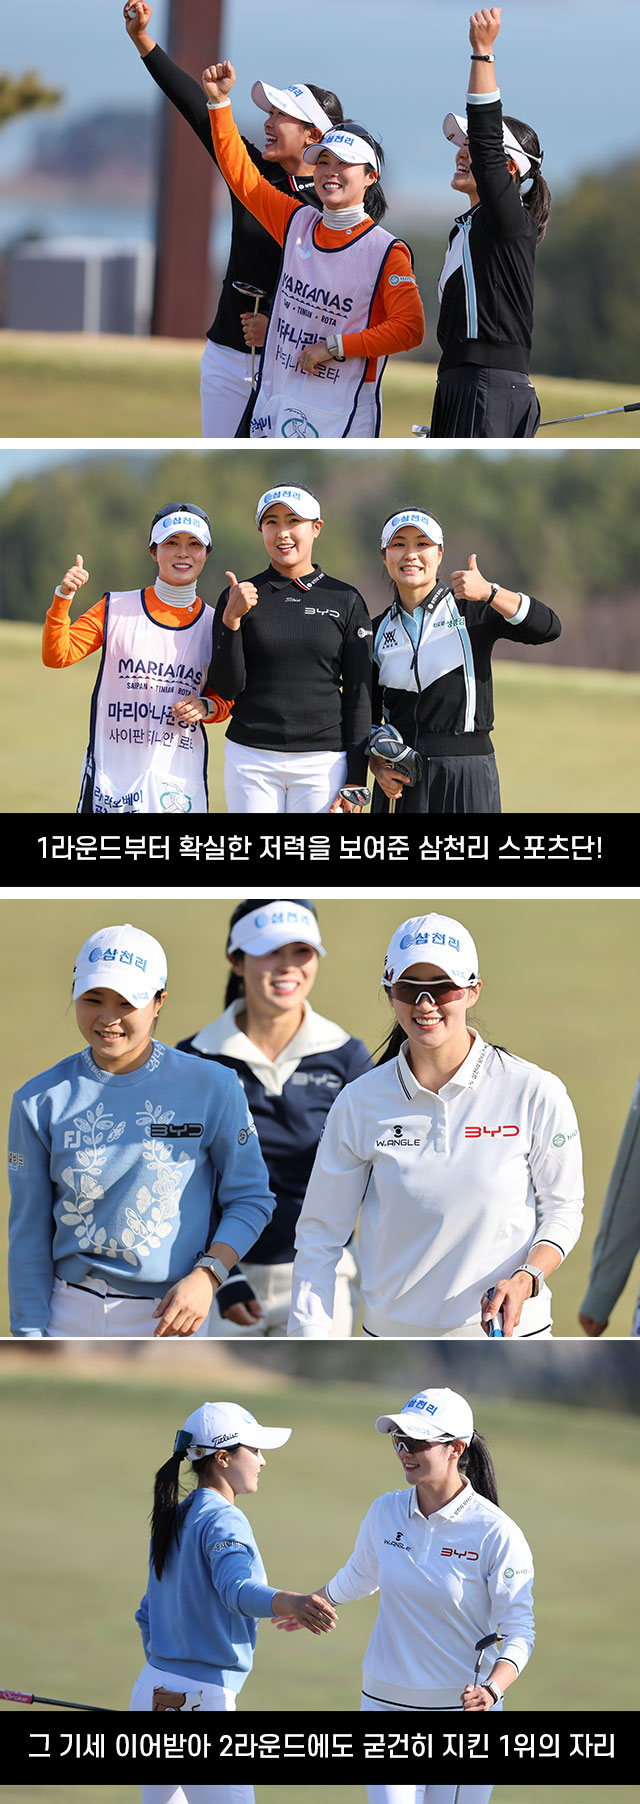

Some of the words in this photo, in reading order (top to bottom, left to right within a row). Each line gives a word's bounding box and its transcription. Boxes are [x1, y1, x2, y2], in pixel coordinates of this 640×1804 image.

[272, 490, 301, 501] 삼천리
[401, 514, 429, 526] 삼천리
[304, 607, 340, 618] BYD
[118, 658, 203, 686] MARIANAS
[127, 682, 148, 690] SAIPAN
[109, 728, 144, 744] 사이판
[271, 912, 311, 926] 삼천리
[415, 931, 461, 952] 삼천리
[102, 948, 148, 972] 삼천리
[151, 1125, 203, 1137] BYD
[464, 1125, 520, 1138] BYD
[64, 1130, 81, 1149] FJ
[440, 1547, 479, 1561] BYD
